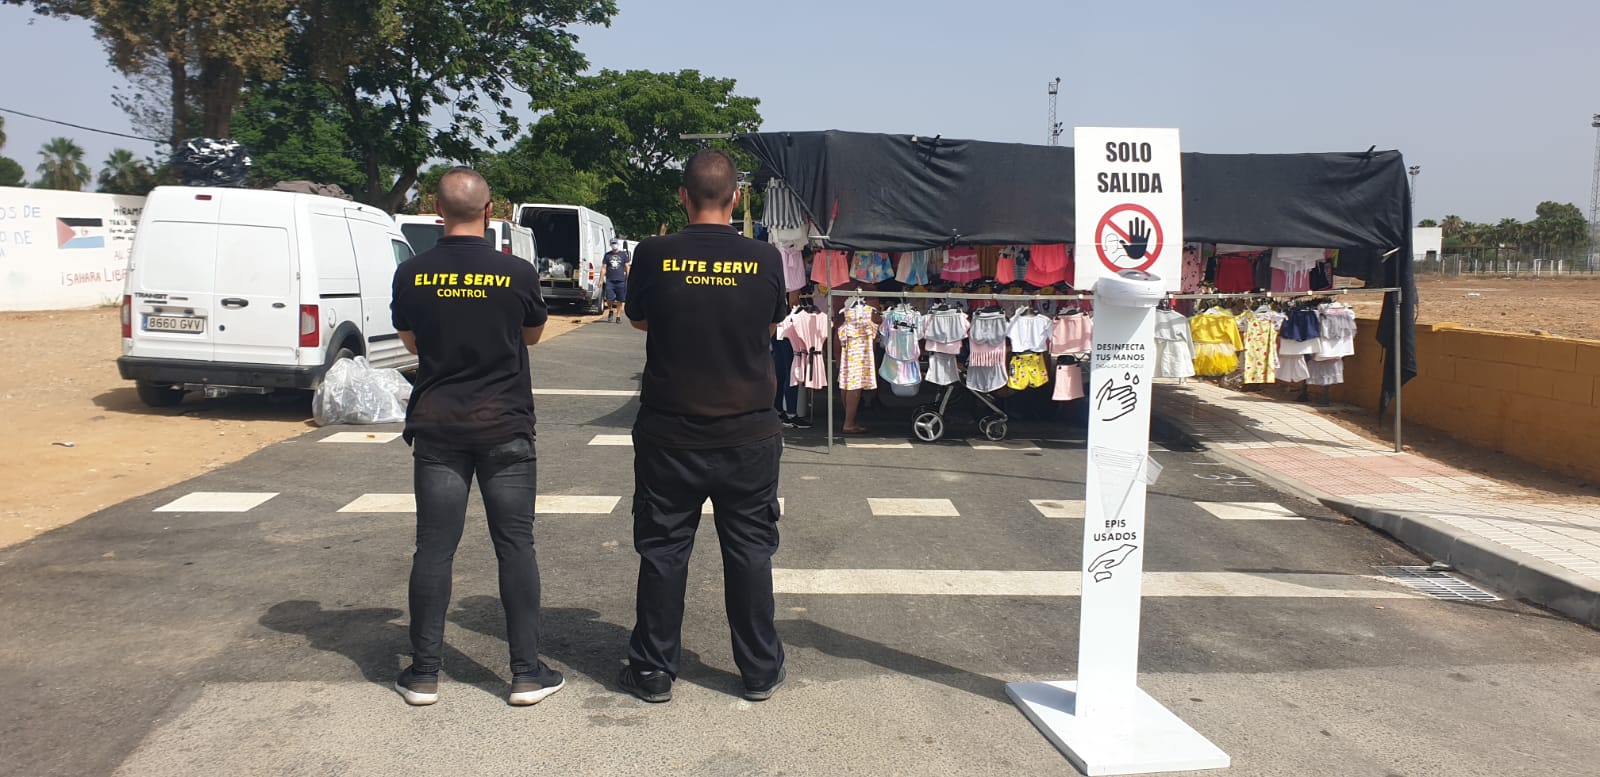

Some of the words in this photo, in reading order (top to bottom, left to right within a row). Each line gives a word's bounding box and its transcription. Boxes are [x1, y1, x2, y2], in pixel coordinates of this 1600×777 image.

[1105, 141, 1152, 163] SOLO
[1097, 172, 1163, 193] SALIDA
[23, 204, 41, 219] DE
[14, 230, 32, 245] DE
[662, 259, 706, 272] ELITE
[713, 261, 758, 274] SERVI
[414, 273, 458, 286] ELITE
[463, 273, 511, 287] SERVI
[685, 275, 738, 286] CONTROL
[134, 292, 168, 300] TRANSIT
[437, 288, 488, 298] CONTROL
[149, 317, 177, 329] 8660
[179, 318, 201, 331] GVV
[1096, 343, 1145, 351] DESINFECTA
[1095, 353, 1111, 361] TUS
[1113, 353, 1145, 361] MANOS
[1105, 519, 1126, 528] EPIS
[1093, 531, 1137, 542] USADOS
